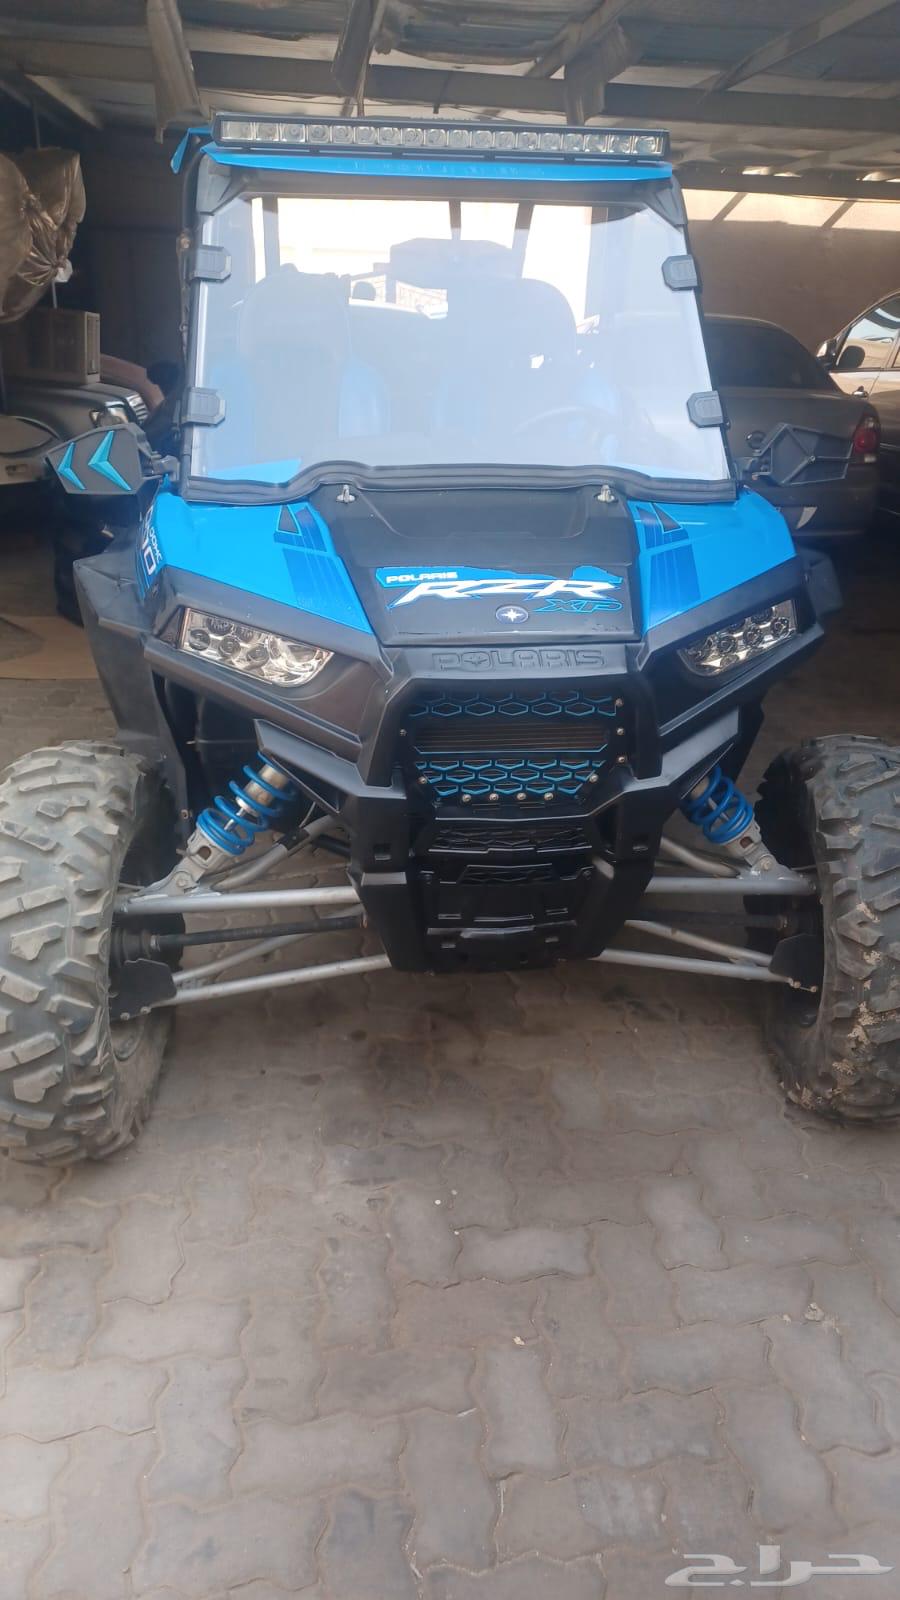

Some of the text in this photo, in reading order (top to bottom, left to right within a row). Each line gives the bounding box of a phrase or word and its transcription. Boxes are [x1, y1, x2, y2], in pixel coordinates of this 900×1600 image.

[386, 571, 459, 584] POLARIS
[387, 579, 617, 609] RZR
[532, 599, 624, 614] XP
[432, 649, 606, 672] POLARIS
